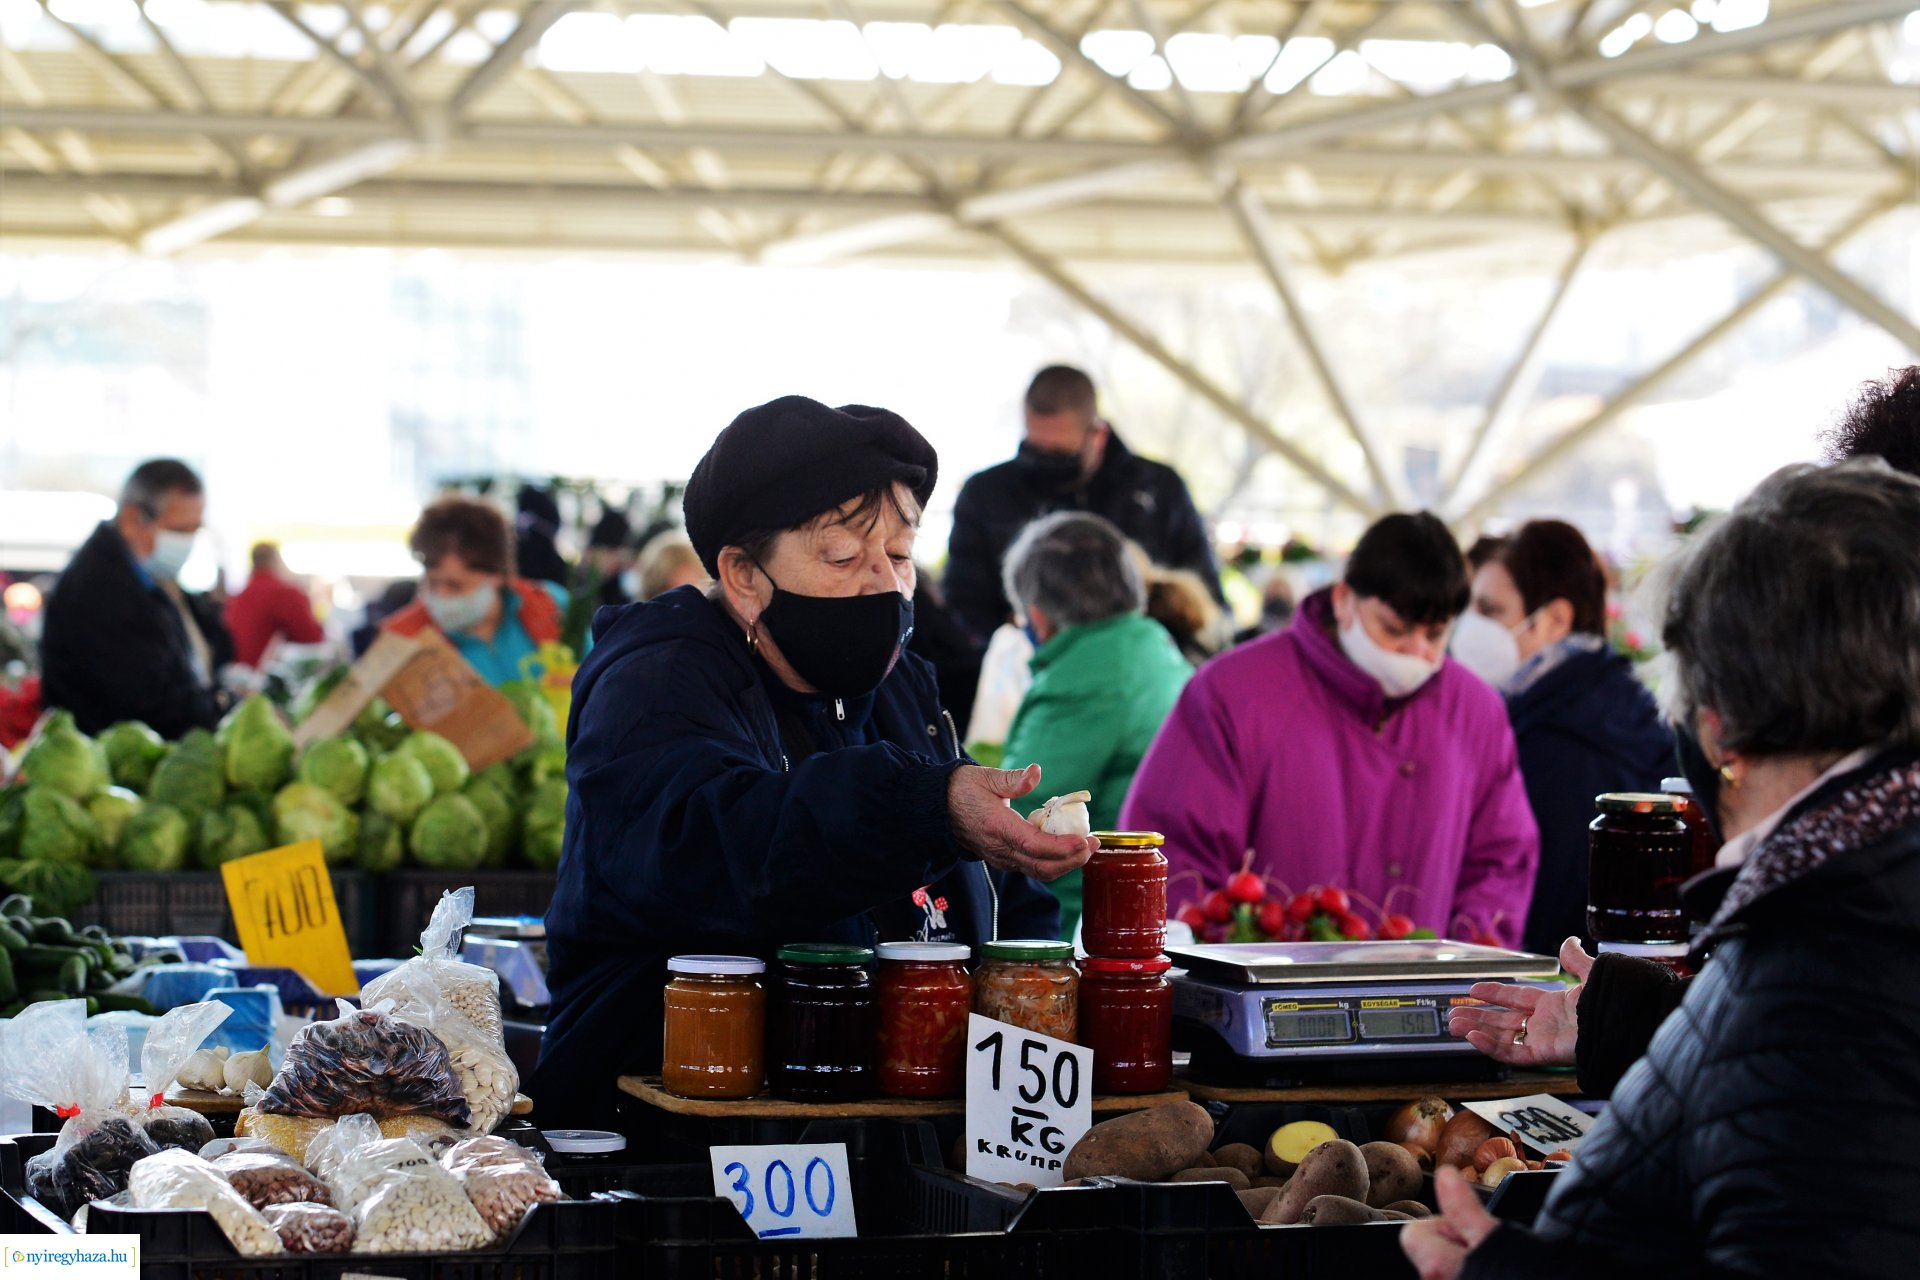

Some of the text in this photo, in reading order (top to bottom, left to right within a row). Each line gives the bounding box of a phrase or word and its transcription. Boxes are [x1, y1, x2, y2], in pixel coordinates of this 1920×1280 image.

[1338, 1001, 1350, 1010] kg
[1416, 998, 1437, 1007] Ft/kg
[1401, 1012, 1425, 1035] 150
[975, 1031, 1079, 1109] 150
[1011, 1116, 1066, 1154] KG
[724, 1156, 835, 1220] 300
